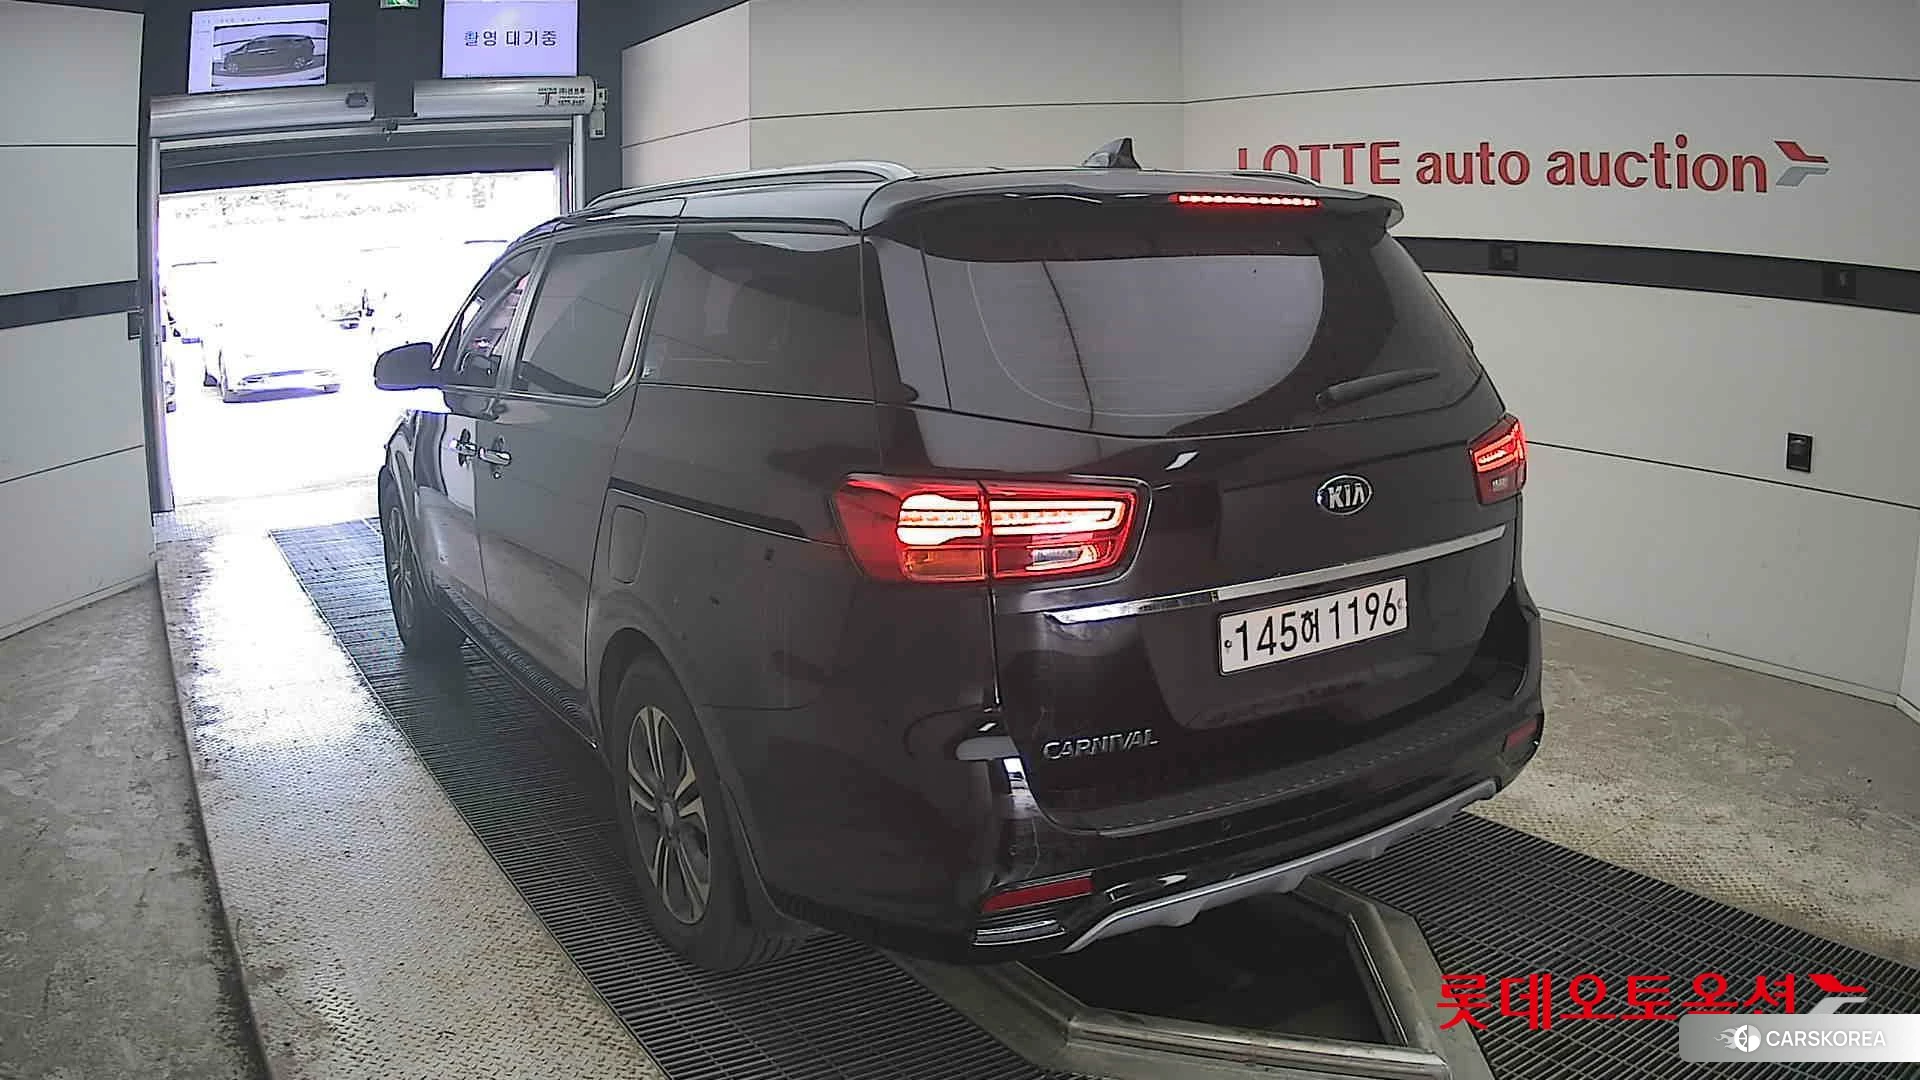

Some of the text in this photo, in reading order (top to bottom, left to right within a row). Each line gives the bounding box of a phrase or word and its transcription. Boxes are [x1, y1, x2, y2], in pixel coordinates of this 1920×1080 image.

[506, 30, 557, 47] 대기중
[1416, 141, 1530, 186] auto
[1545, 133, 1767, 193] auction
[1328, 483, 1365, 509] KIA
[1329, 588, 1398, 640] 1196
[1042, 729, 1160, 760] CARNIVAL
